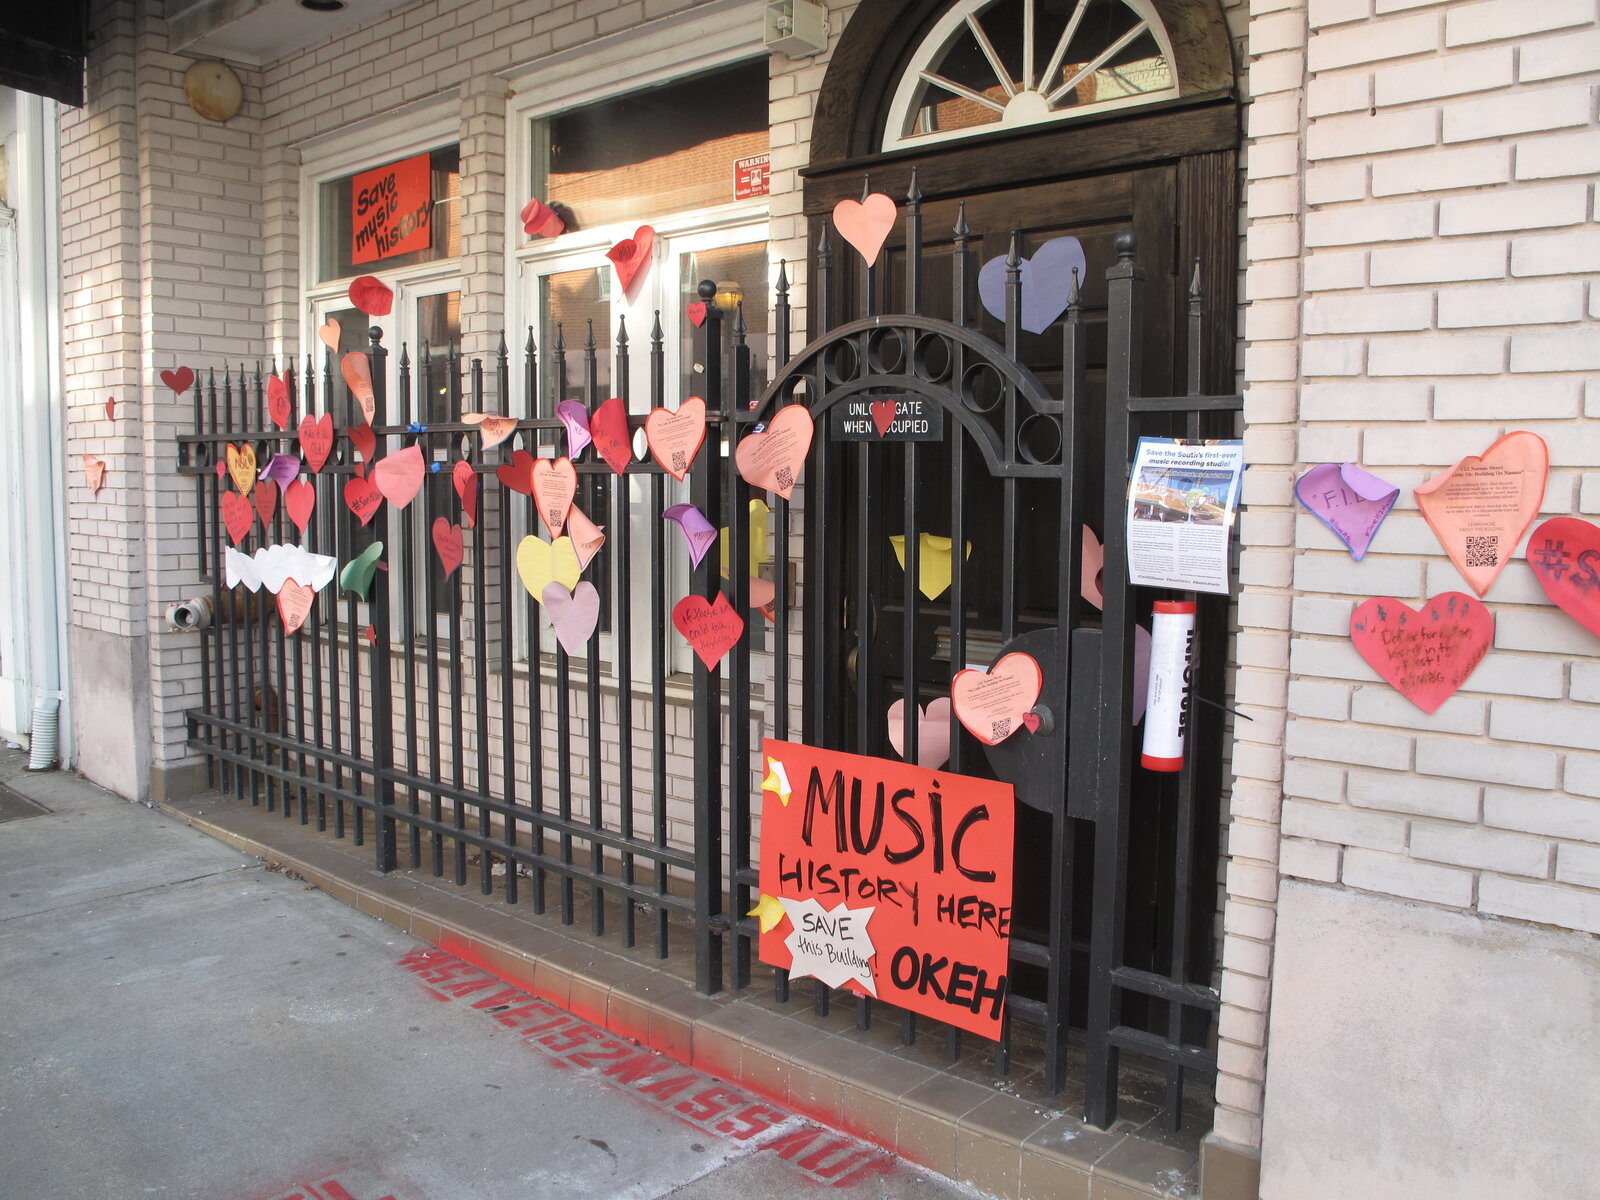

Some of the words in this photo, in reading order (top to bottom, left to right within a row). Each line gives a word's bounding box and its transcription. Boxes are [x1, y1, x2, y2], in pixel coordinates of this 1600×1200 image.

[738, 155, 770, 168] WARNIN
[356, 172, 396, 216] Save
[356, 192, 398, 252] music
[375, 200, 436, 258] history
[896, 402, 922, 414] GATE
[844, 420, 872, 433] WHEN
[886, 420, 928, 433] CUPIED
[1170, 459, 1205, 467] recording
[1534, 540, 1600, 593] #S
[780, 853, 919, 926] HISTORY
[937, 894, 1012, 938] HERE
[802, 912, 854, 940] SAVE
[798, 937, 823, 956] this
[890, 946, 1008, 1021] OKEH
